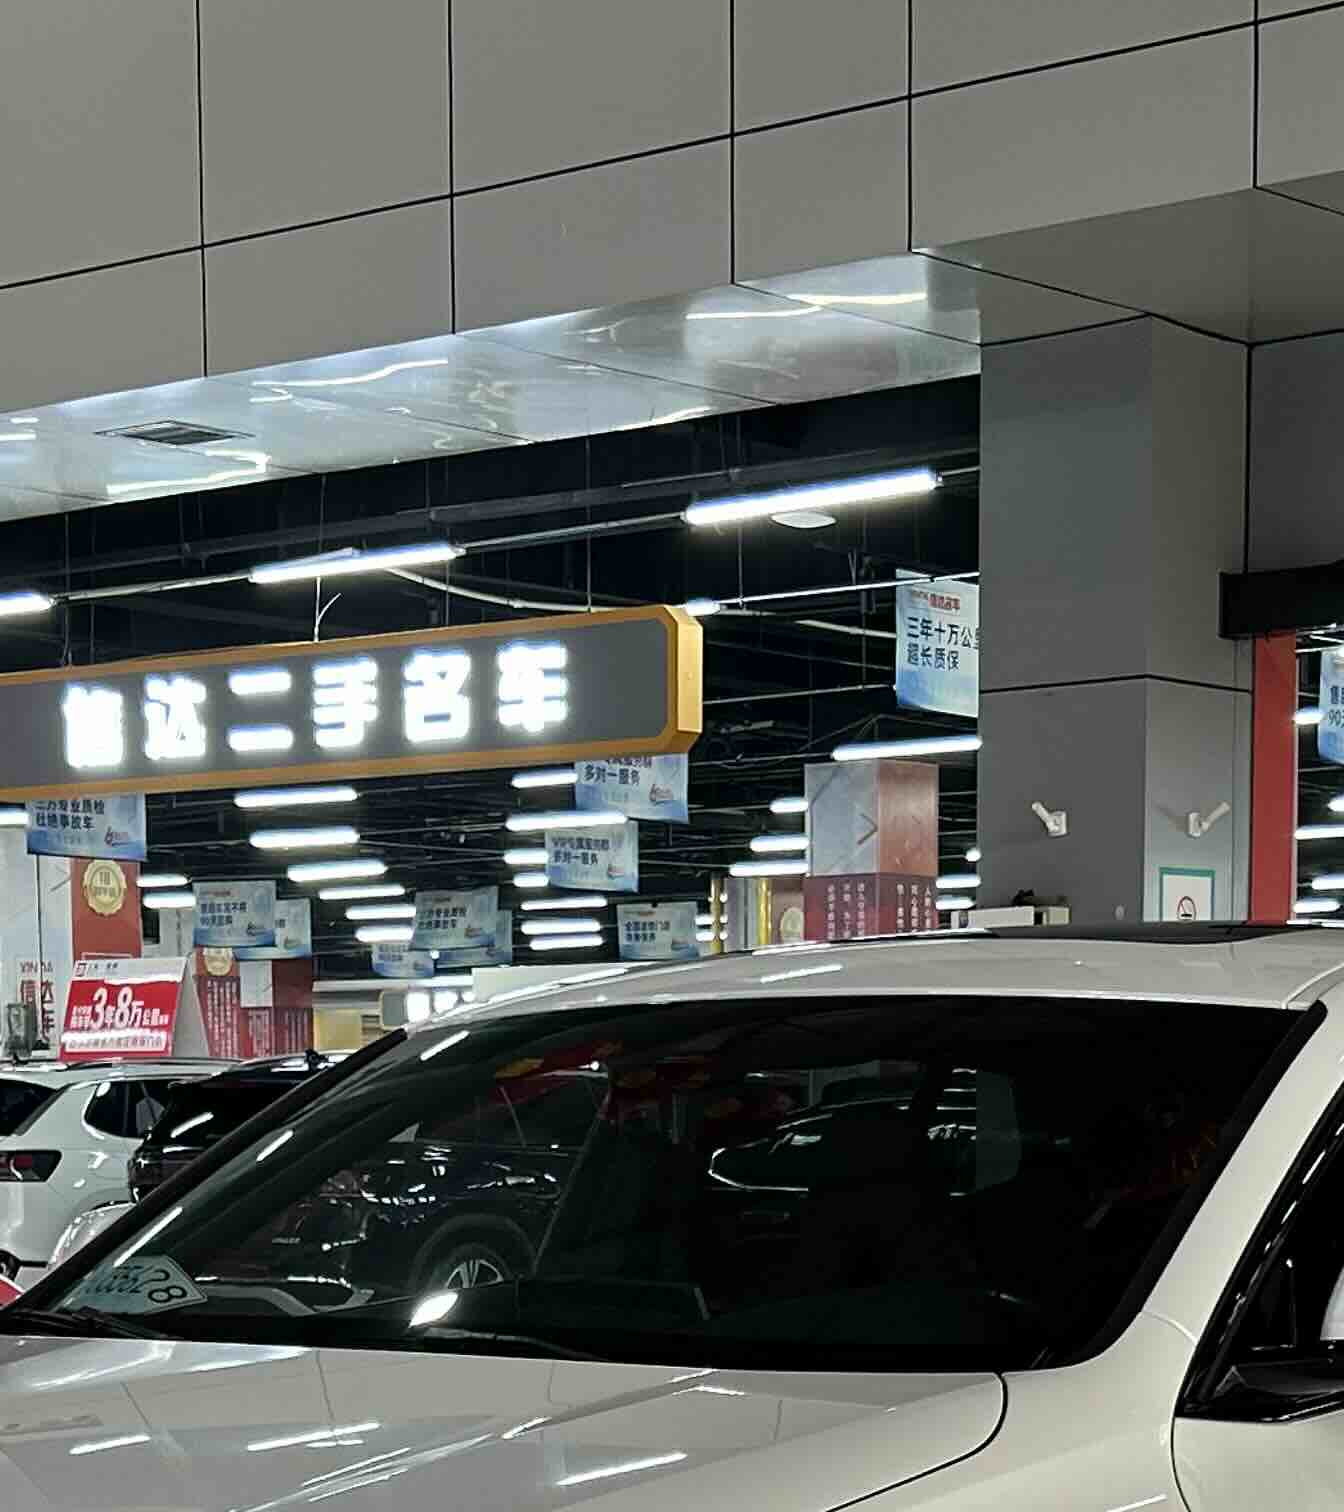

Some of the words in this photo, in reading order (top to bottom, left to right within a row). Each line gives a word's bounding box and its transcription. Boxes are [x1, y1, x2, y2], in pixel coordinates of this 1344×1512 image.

[906, 642, 960, 671] 超长质保
[62, 640, 570, 771] 信达二手名车
